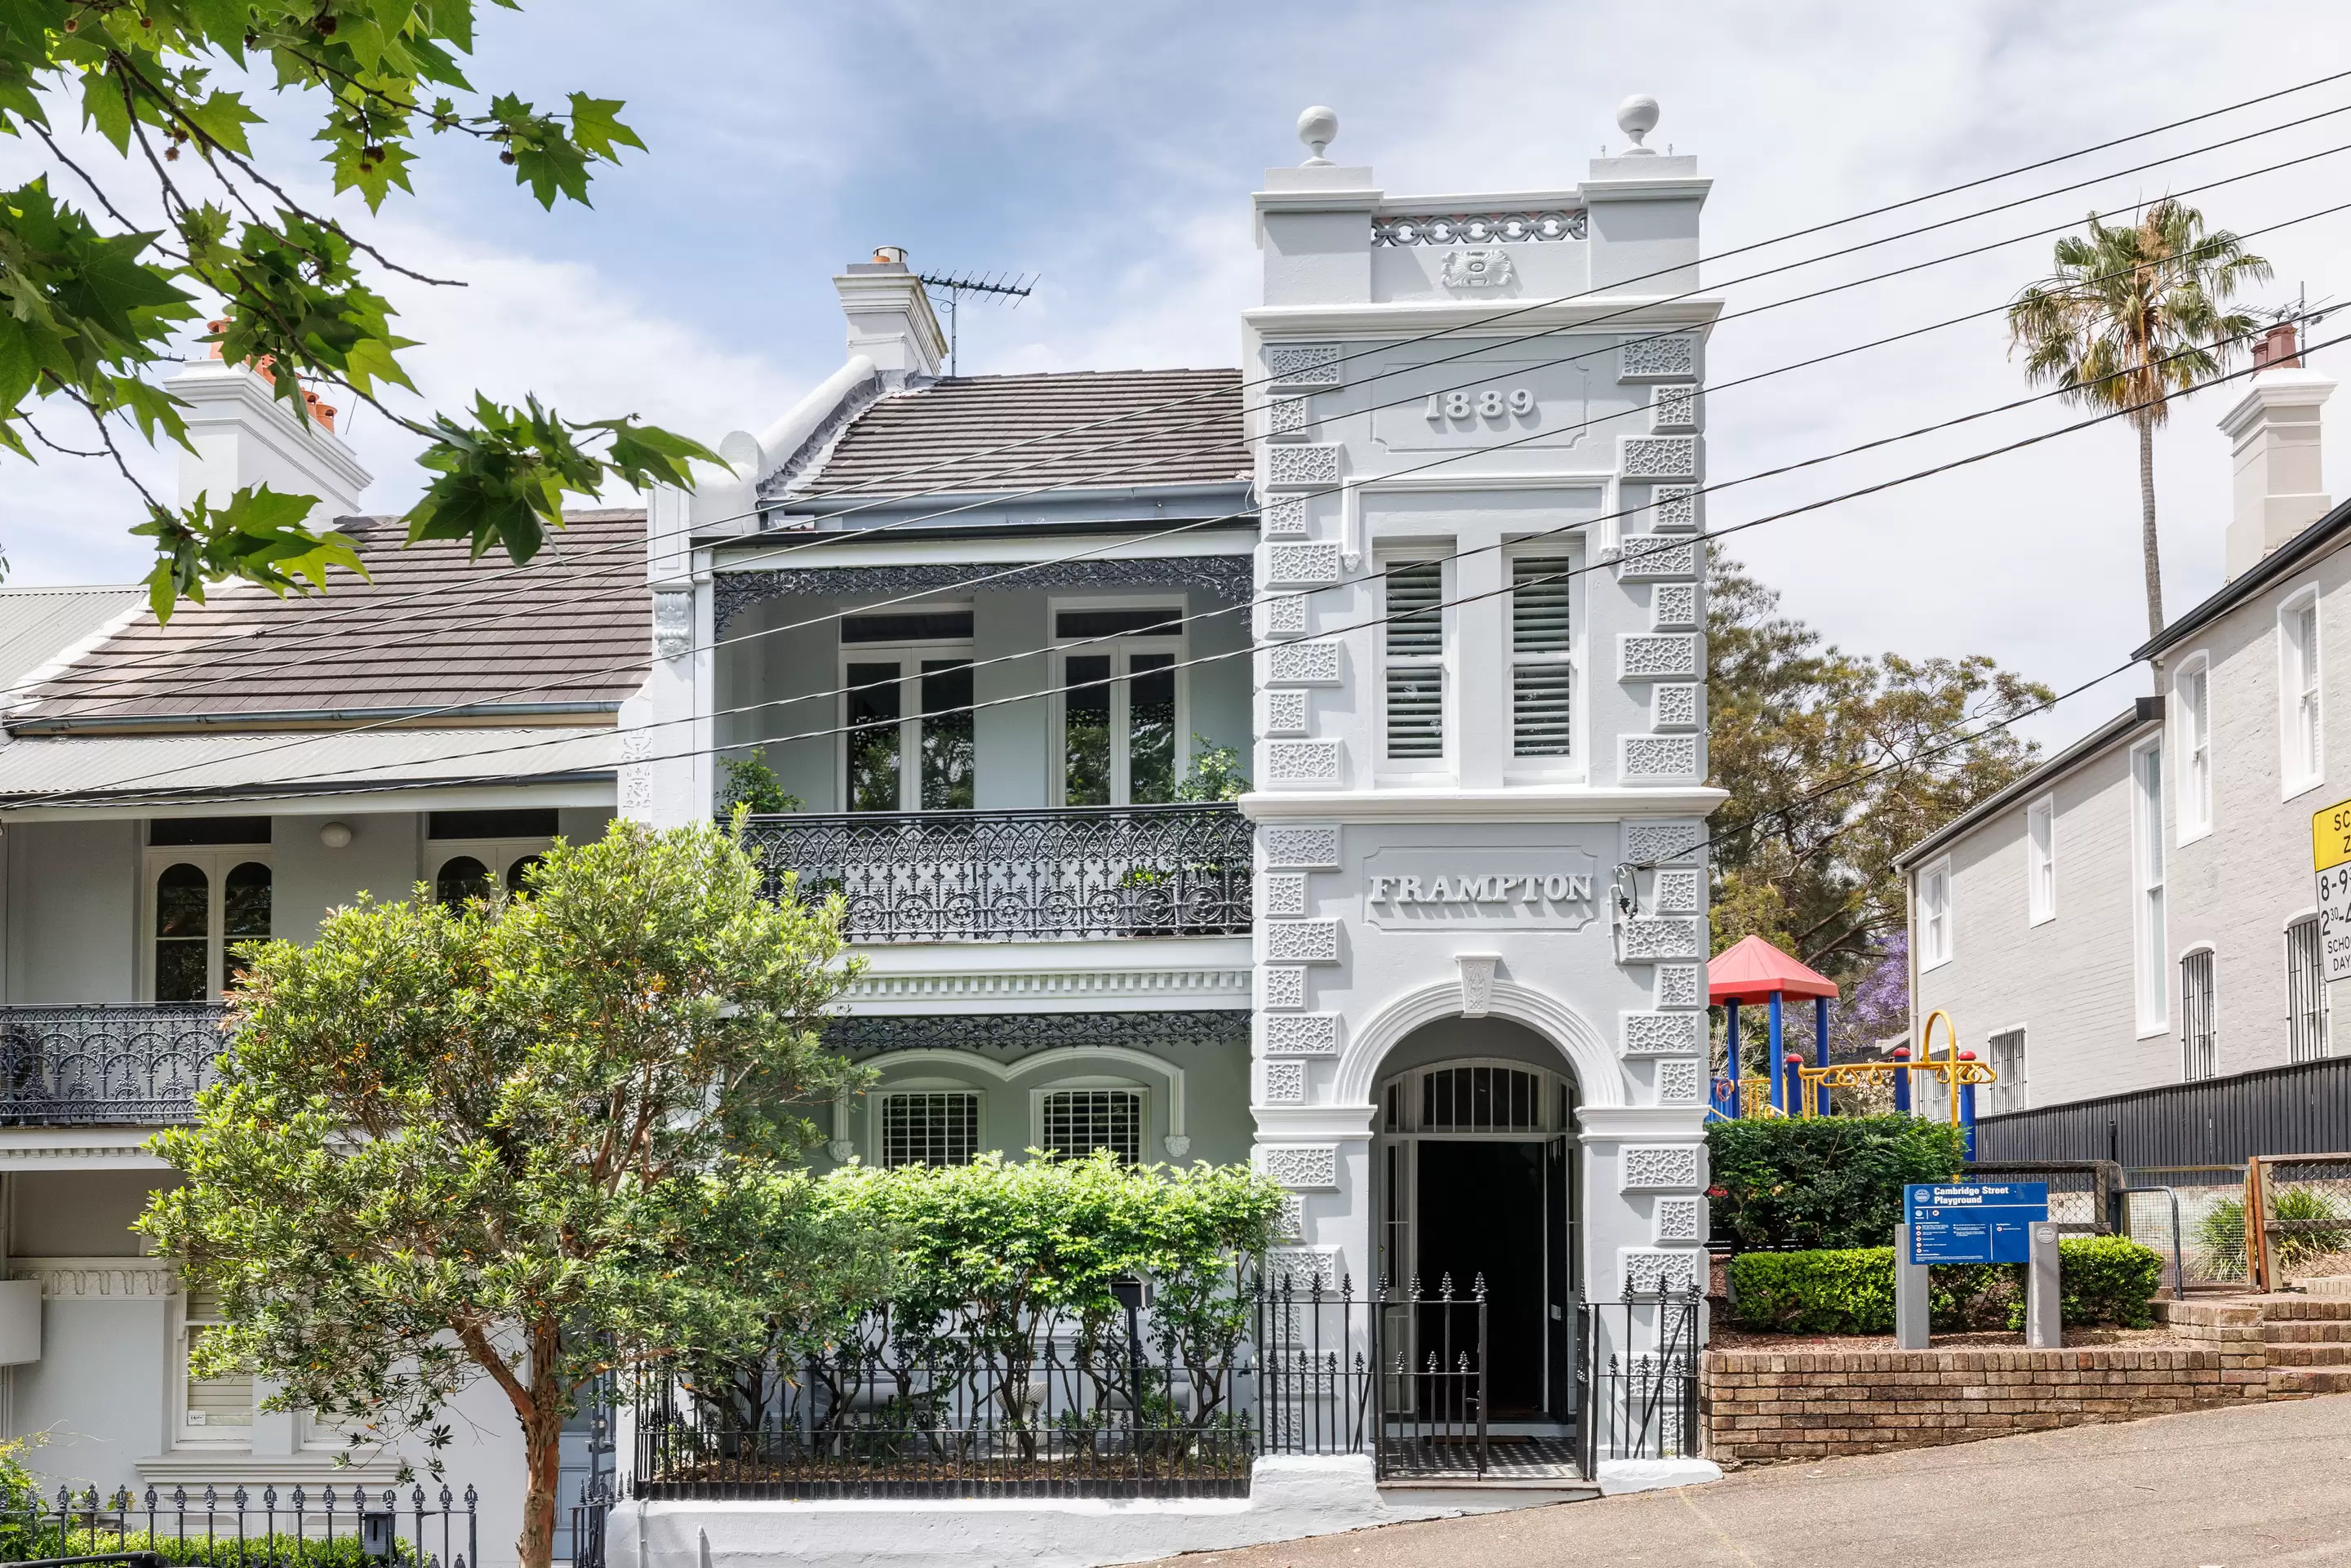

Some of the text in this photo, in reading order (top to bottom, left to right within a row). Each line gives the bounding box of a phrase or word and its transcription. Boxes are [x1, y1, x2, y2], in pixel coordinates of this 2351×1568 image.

[1425, 389, 1535, 420] 1889
[1370, 873, 1593, 904] FRAMPTON
[2327, 935, 2351, 954] SCHO
[1934, 1187, 1980, 1196] Cambridge
[1982, 1186, 2009, 1195] Street
[1934, 1195, 1983, 1206] Playground
